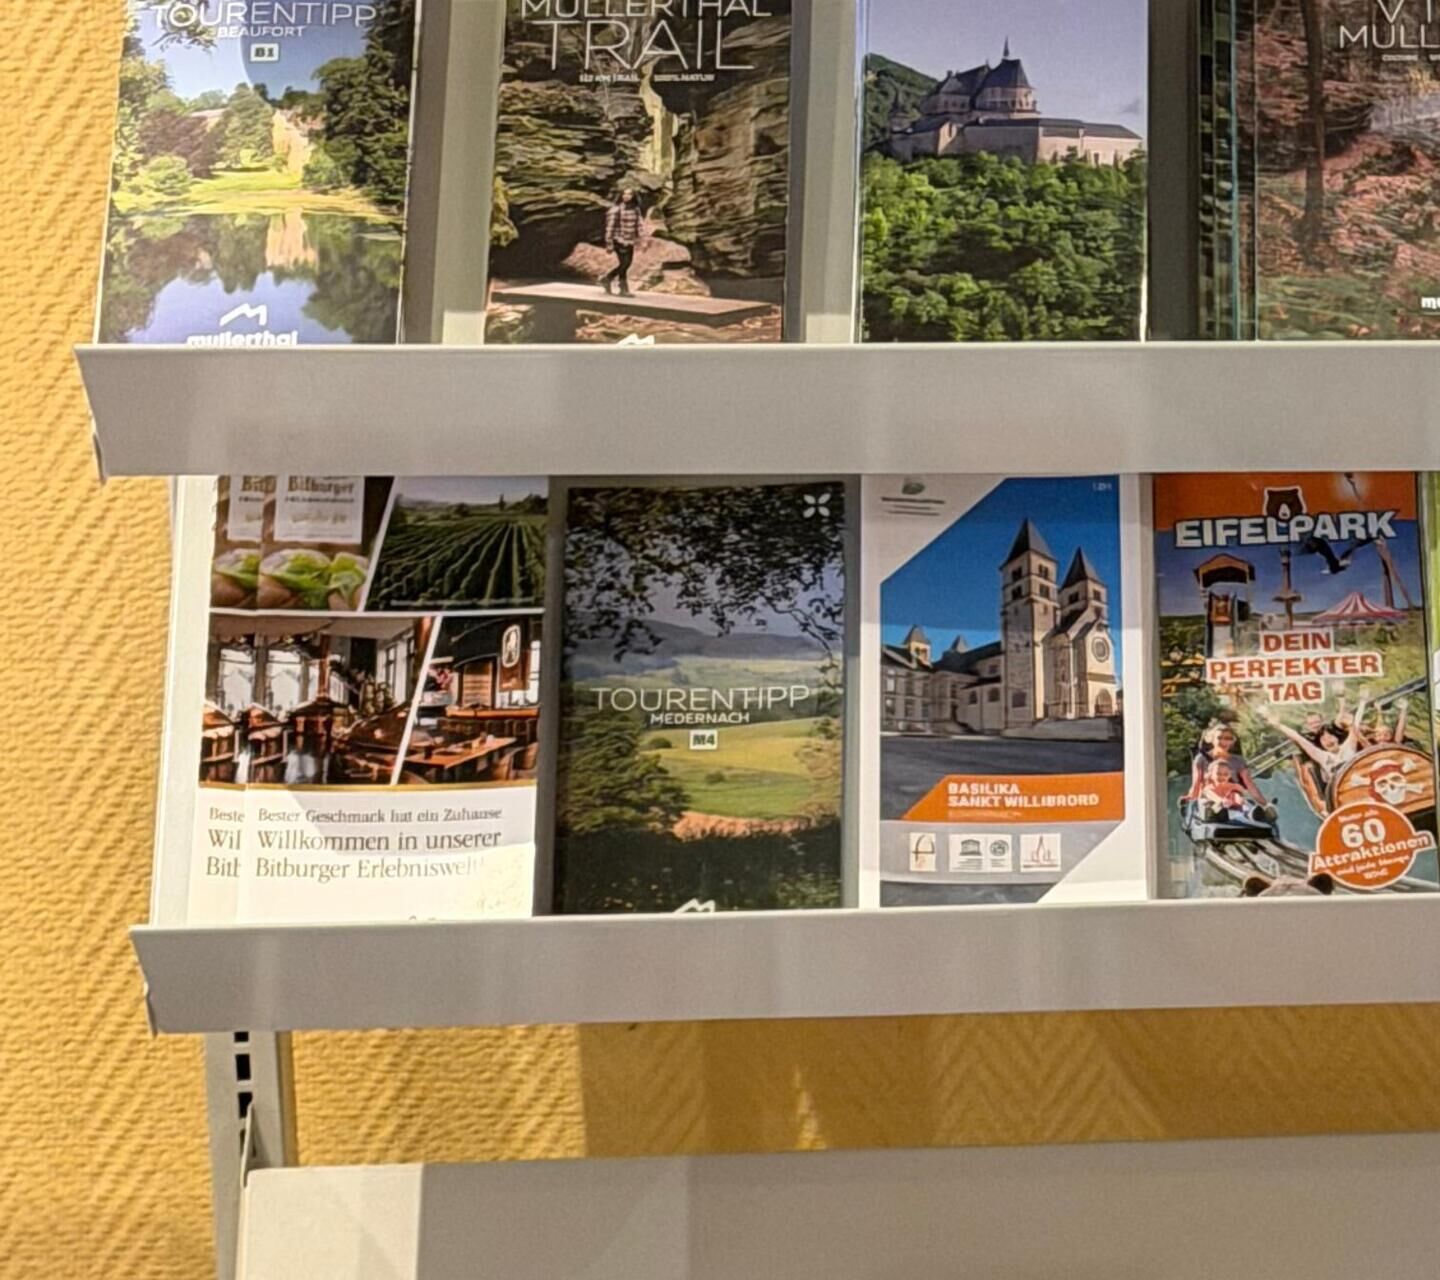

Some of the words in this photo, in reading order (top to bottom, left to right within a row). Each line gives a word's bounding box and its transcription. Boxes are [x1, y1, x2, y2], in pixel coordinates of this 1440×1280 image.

[150, 0, 378, 29] TOURENTIPP
[216, 24, 308, 39] BEAUFORT
[531, 18, 756, 71] TRAIL
[186, 330, 299, 346] mullerthal
[1176, 511, 1397, 548] EIFELPARK
[1262, 631, 1333, 653] DEIN
[1209, 653, 1380, 680] PERFEKTER
[589, 684, 811, 714] TOURENTIPP
[1268, 681, 1323, 702] TAG
[649, 711, 750, 726] MEDERNACH
[692, 733, 715, 747] M4
[948, 782, 1020, 795] BASILIKA
[948, 795, 1001, 808] SANKT
[1004, 794, 1100, 808] WILLIBRORD
[257, 807, 301, 824] Bester
[305, 808, 385, 824] Geschmack
[416, 809, 440, 823] ein
[257, 827, 390, 852] Willkommen
[397, 830, 419, 851] in
[424, 827, 502, 851] unserer
[1341, 817, 1387, 849] 60
[1313, 835, 1430, 871] Attraktionen
[255, 856, 351, 884] Bitburger
